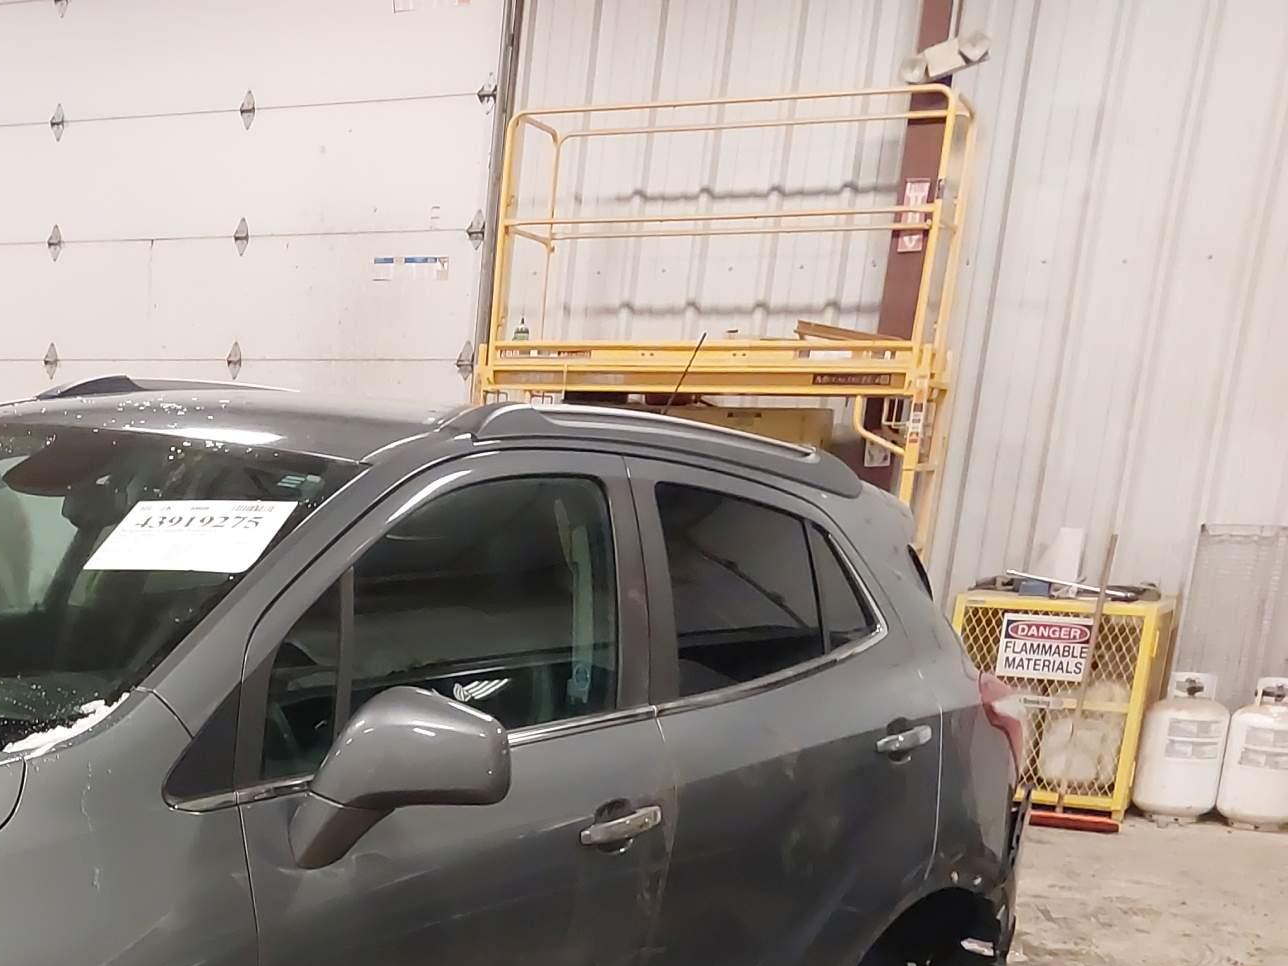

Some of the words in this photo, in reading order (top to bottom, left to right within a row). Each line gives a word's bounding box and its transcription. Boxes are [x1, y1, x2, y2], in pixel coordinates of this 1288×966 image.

[135, 515, 264, 529] 43919275
[1016, 624, 1081, 640] DANGER
[1004, 640, 1089, 660] FLAMMABLE
[1004, 655, 1083, 675] MATERIALS
